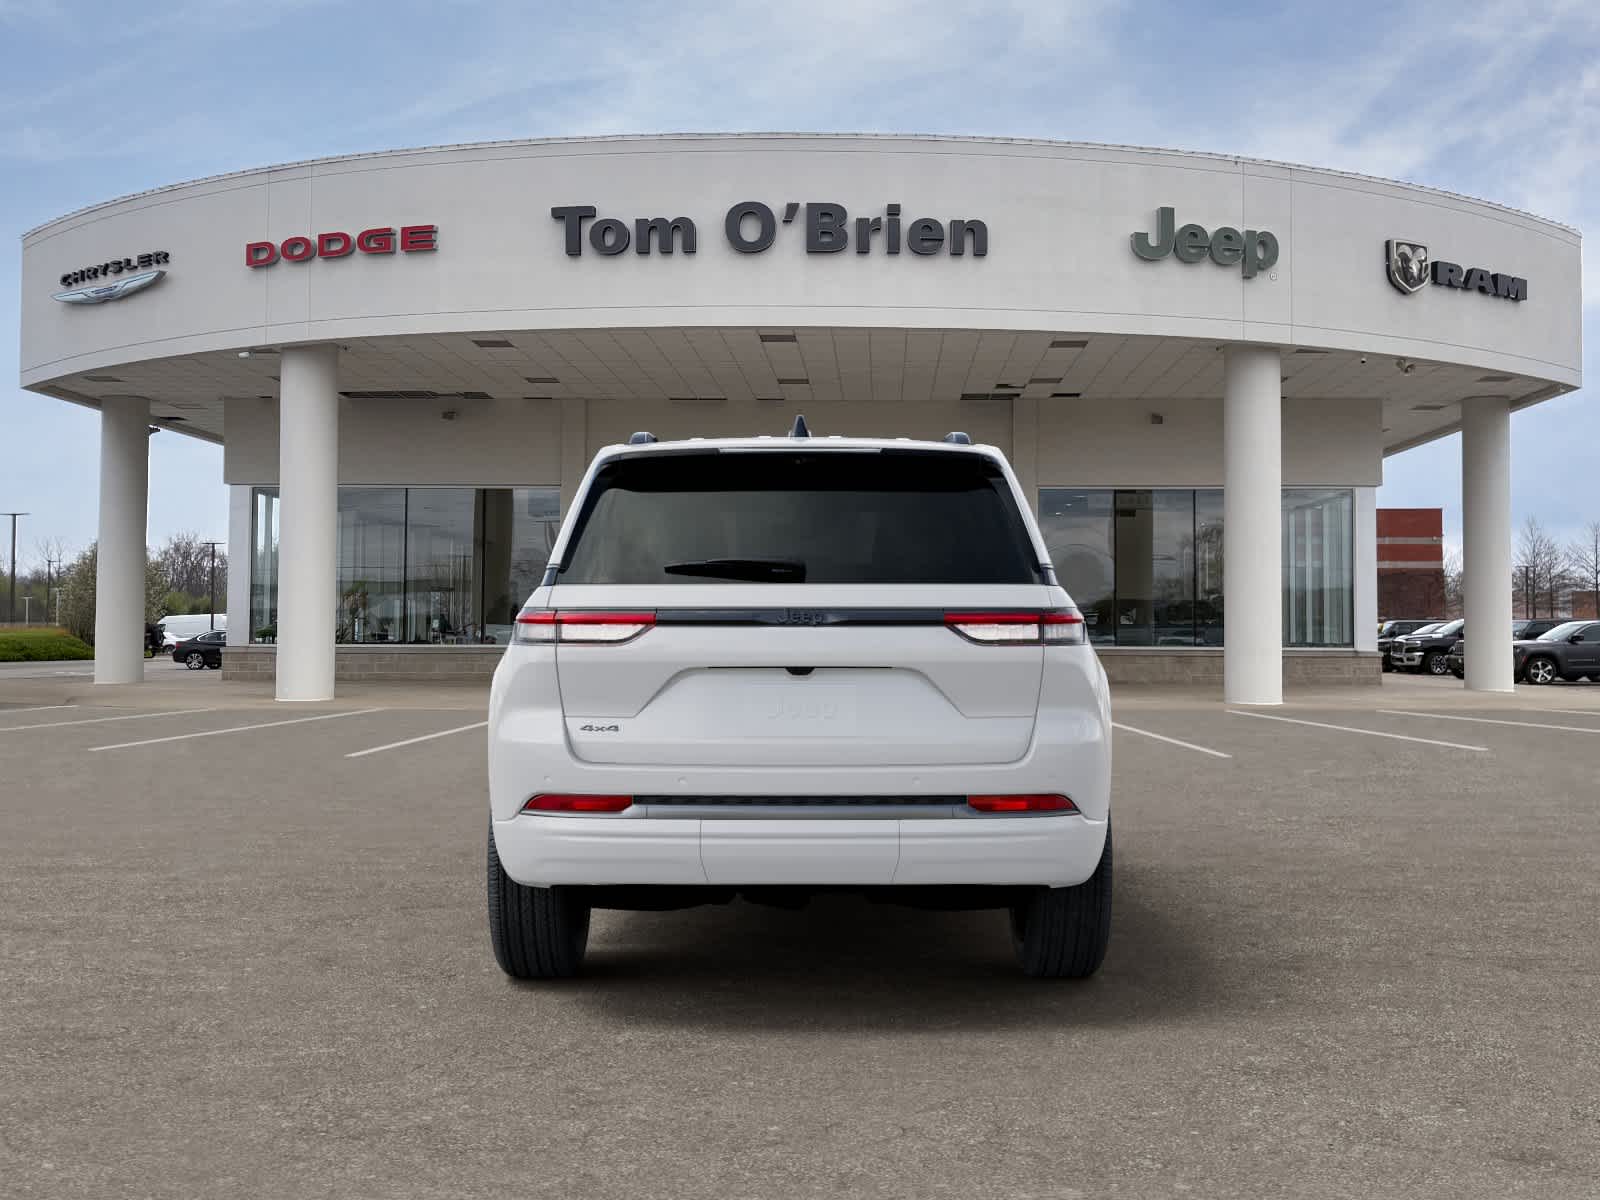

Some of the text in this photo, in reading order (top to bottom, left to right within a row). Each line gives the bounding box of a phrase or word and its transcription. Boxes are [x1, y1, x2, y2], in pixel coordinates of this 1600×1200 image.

[245, 225, 438, 268] DODGE
[551, 201, 988, 256] Tom O'Brien
[1130, 206, 1279, 279] Jeep
[60, 251, 170, 286] CHRYSLER
[1430, 260, 1528, 301] RAM
[776, 607, 824, 626] Jeep
